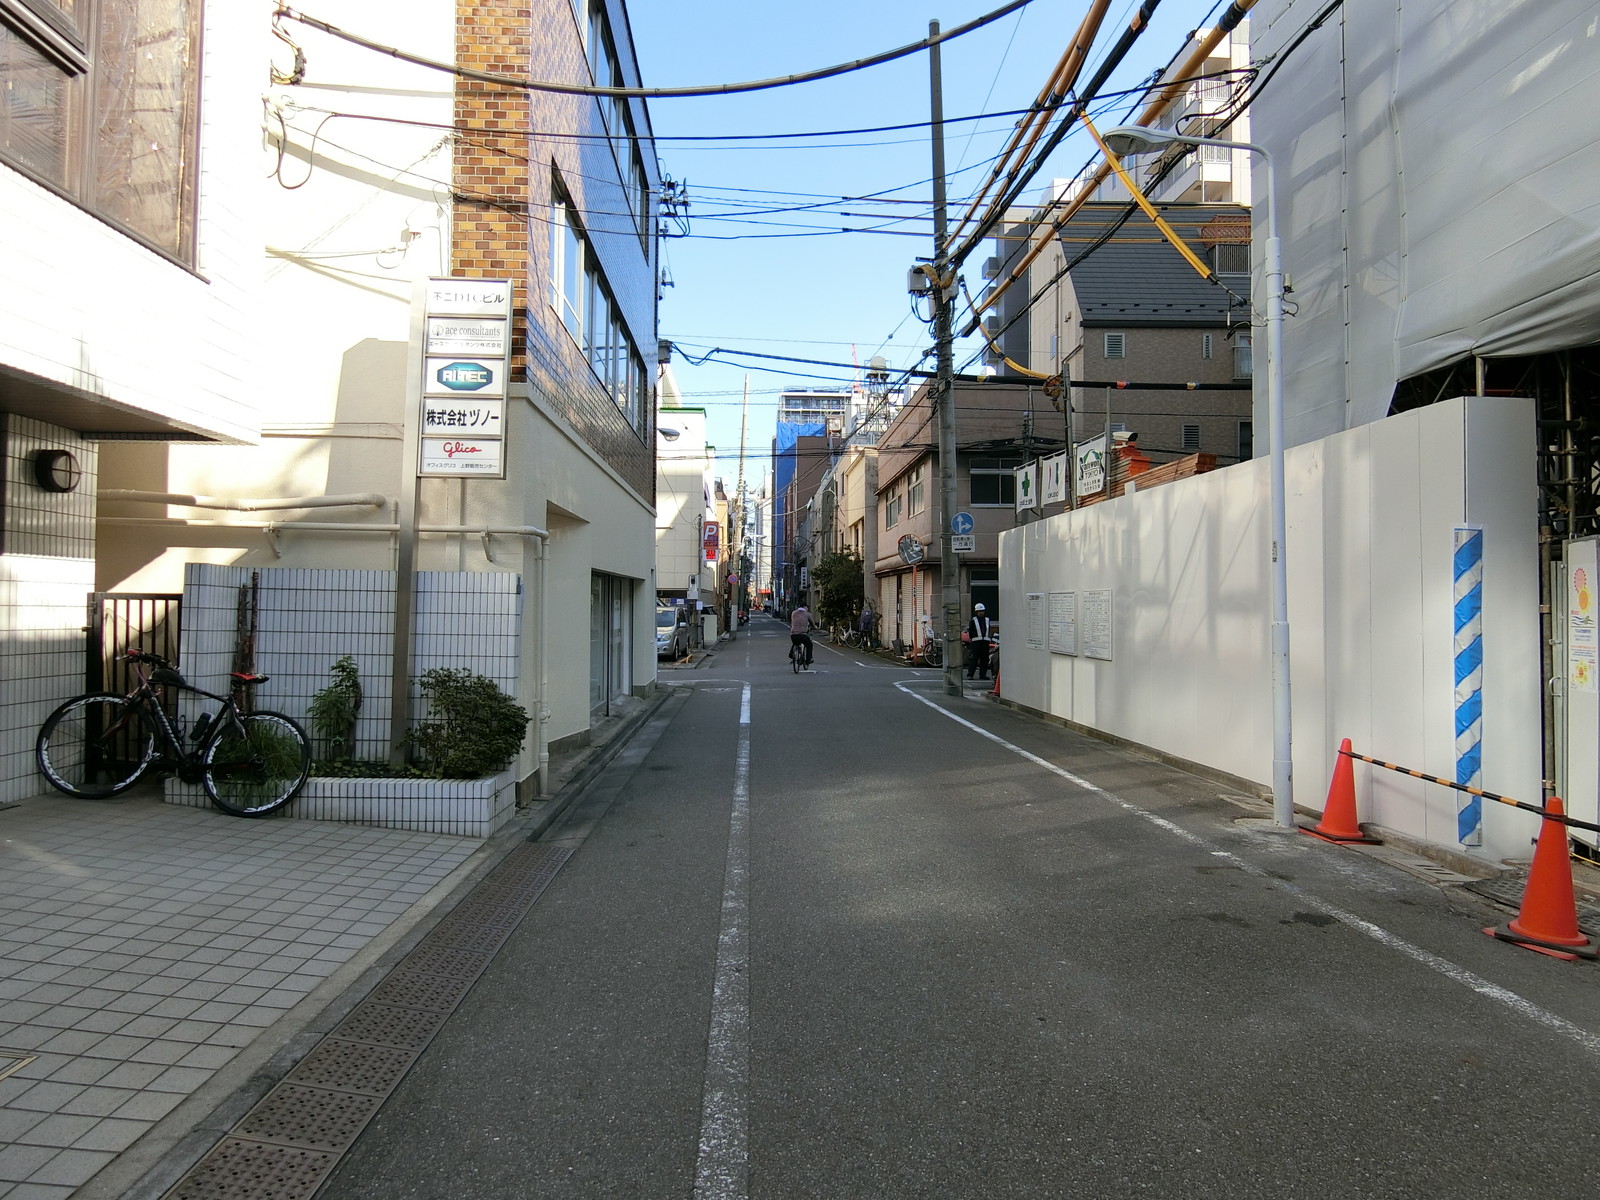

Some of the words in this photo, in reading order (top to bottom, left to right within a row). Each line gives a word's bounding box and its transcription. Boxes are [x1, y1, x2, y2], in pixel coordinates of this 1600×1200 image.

[445, 326, 458, 335] ace
[459, 325, 501, 336] consultants
[443, 442, 483, 458] Glico
[704, 525, 717, 539] P
